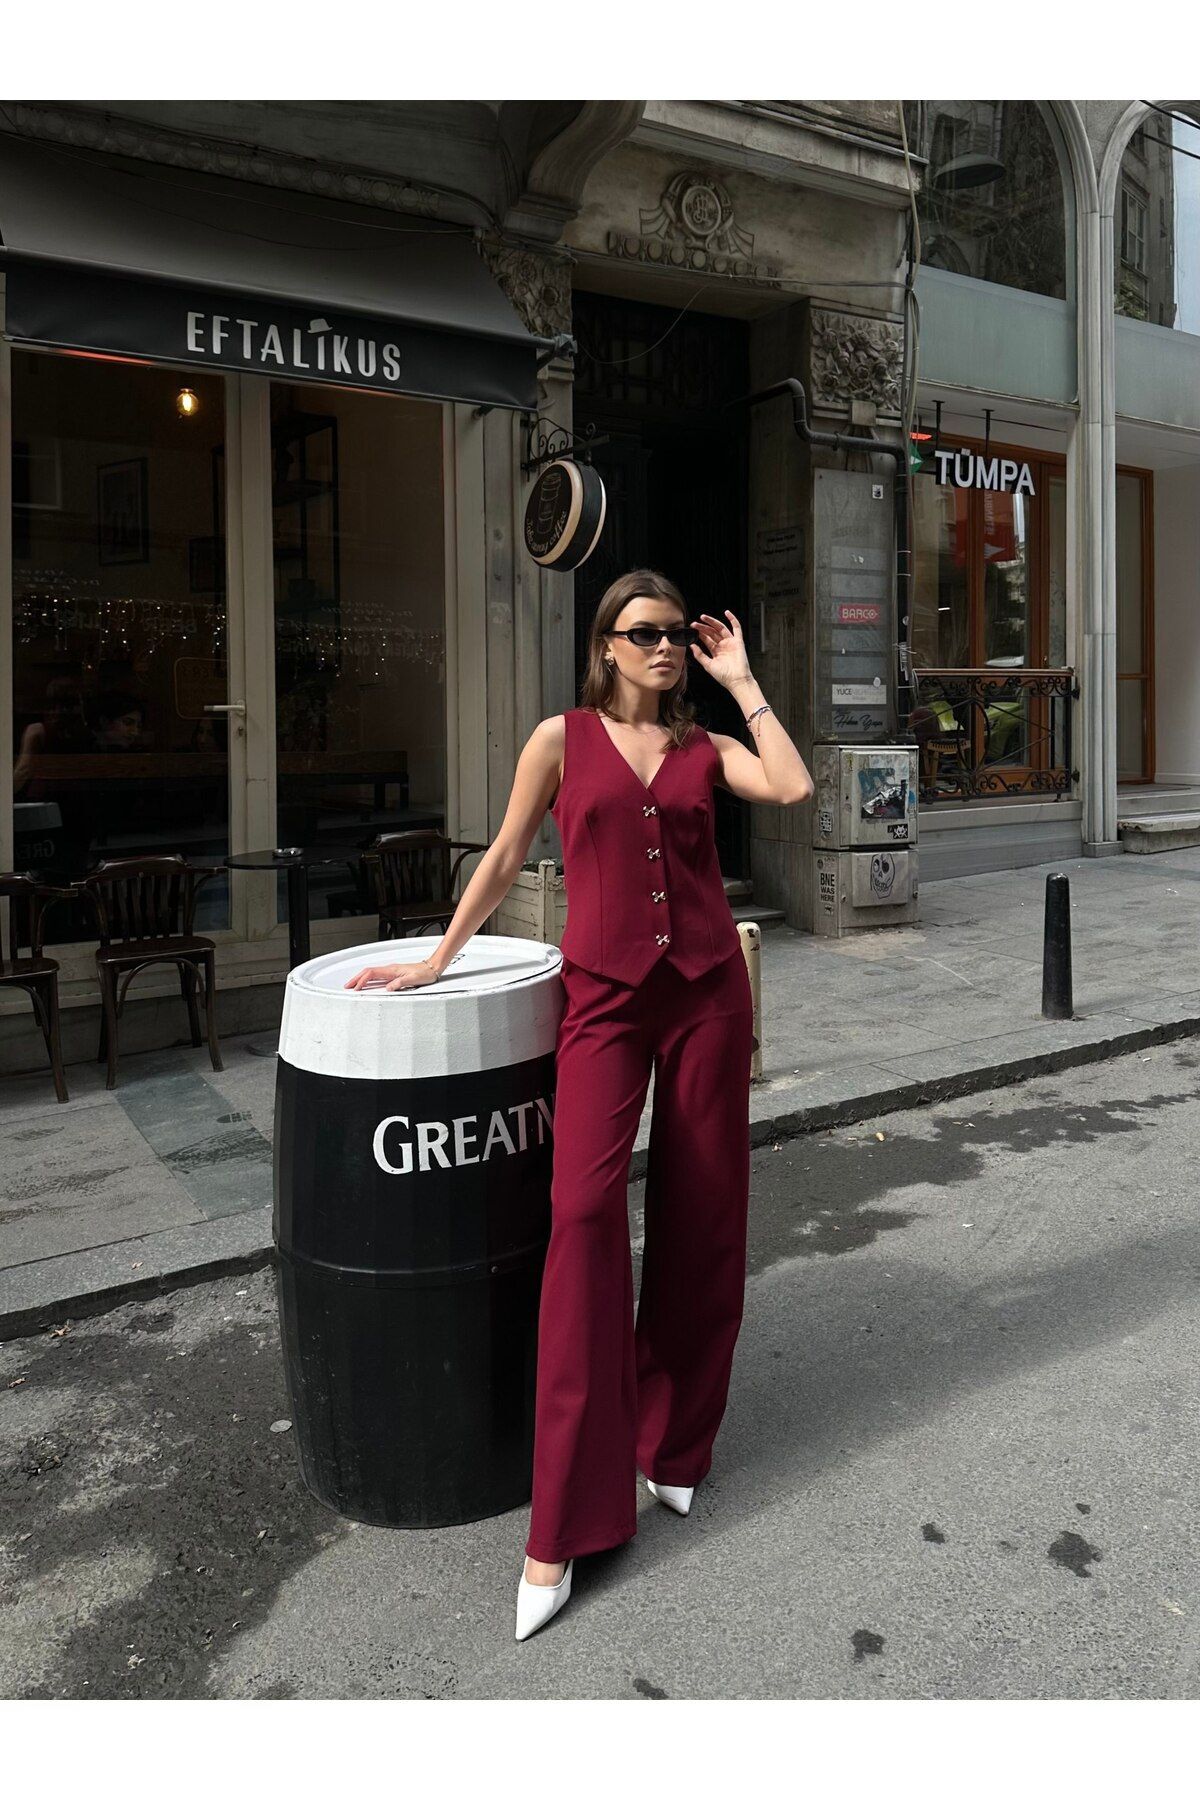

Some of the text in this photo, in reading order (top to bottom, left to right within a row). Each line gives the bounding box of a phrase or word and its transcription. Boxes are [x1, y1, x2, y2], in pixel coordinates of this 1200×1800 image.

[934, 448, 1036, 496] TÜMPA
[820, 873, 835, 887] BNE
[821, 886, 835, 895] WAS
[820, 894, 835, 903] HERE
